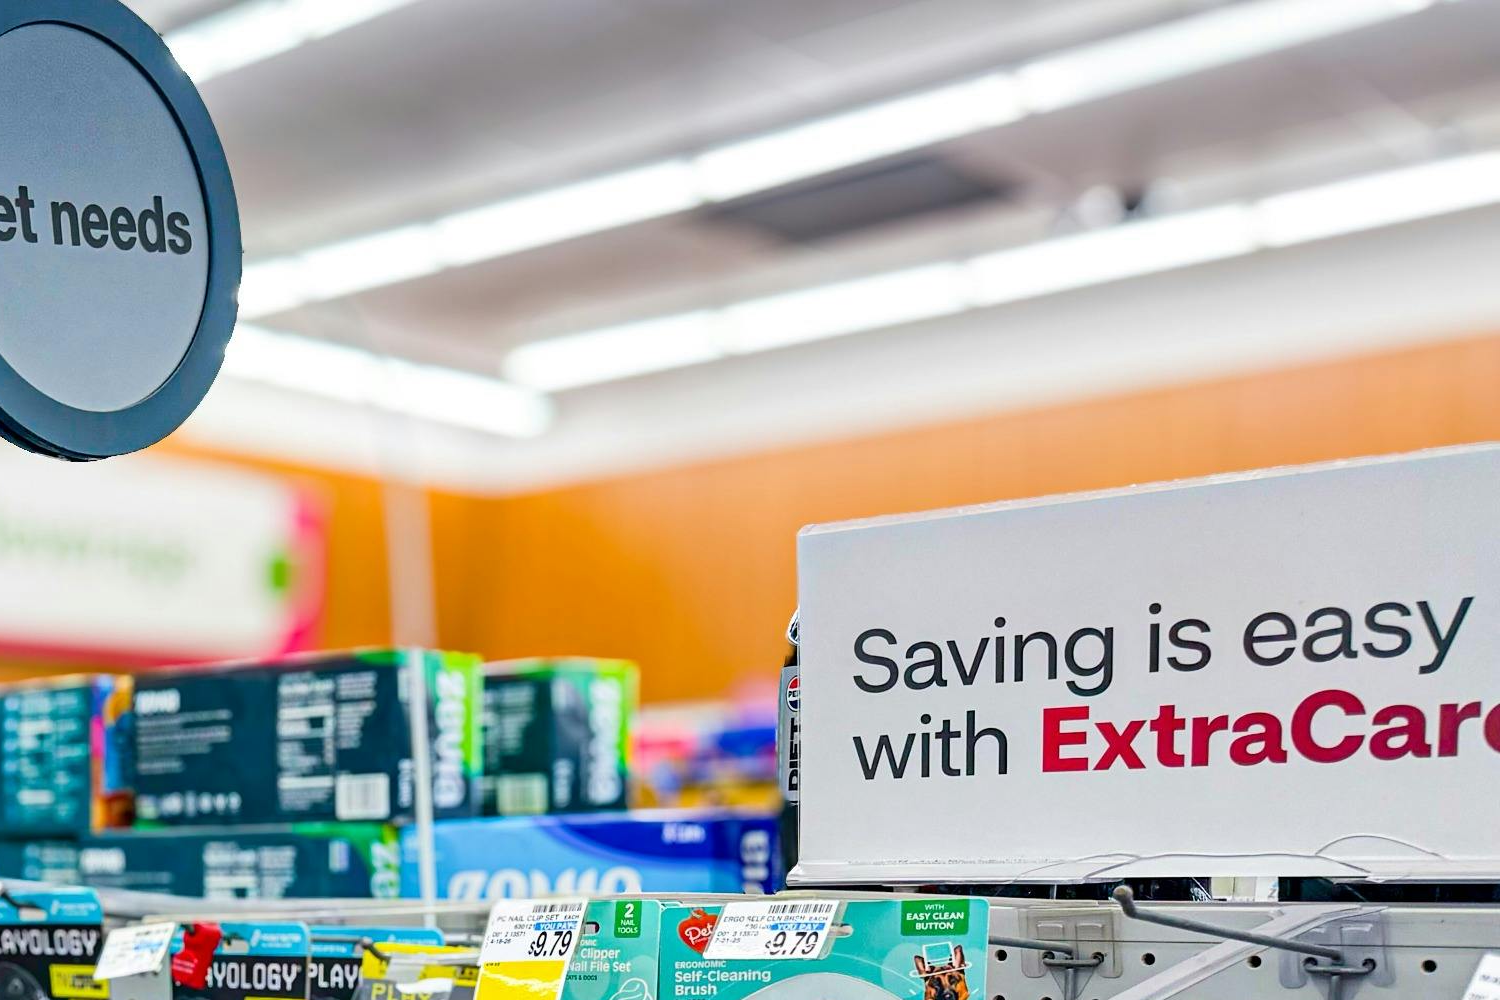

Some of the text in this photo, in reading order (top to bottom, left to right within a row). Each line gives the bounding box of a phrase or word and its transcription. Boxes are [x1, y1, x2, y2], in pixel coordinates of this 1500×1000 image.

[51, 196, 192, 254] needs
[853, 597, 1475, 697] Saving is easy
[853, 689, 1500, 780] with ExtraCar
[624, 904, 634, 918] 2
[907, 912, 964, 921] EASY CLEAN
[916, 922, 954, 930] BUTTON
[528, 931, 572, 956] $9.79
[580, 948, 620, 960] Clipper
[590, 961, 632, 972] File Set
[675, 961, 726, 969] ERGONOMIC
[675, 970, 771, 982] Self-Cleaning
[675, 983, 717, 995] Brush
